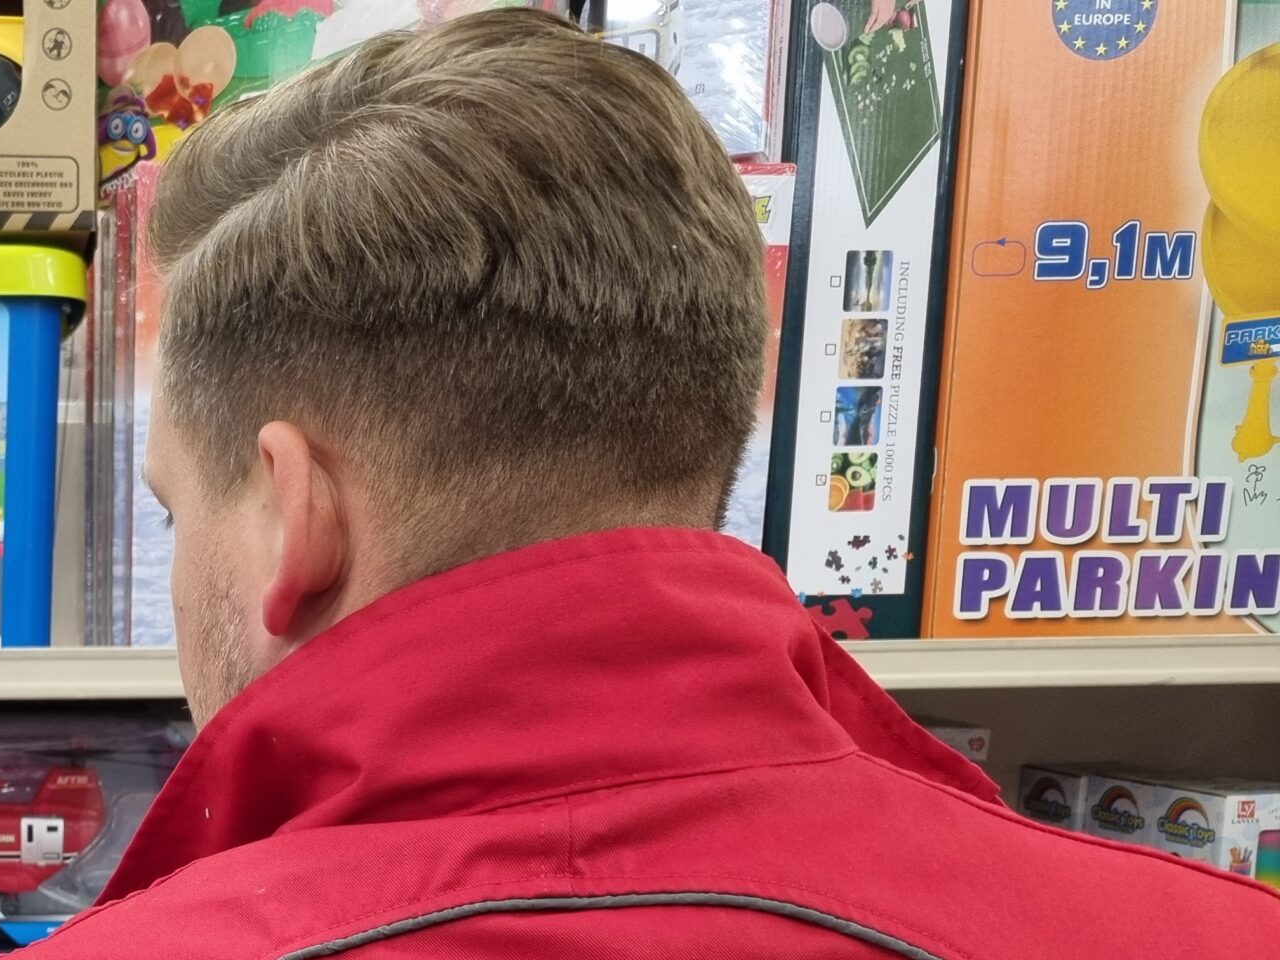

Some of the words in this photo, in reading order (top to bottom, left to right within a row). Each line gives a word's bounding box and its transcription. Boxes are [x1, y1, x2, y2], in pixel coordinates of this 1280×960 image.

[1074, 13, 1131, 26] EUROPE
[1096, 0, 1111, 10] IN
[893, 261, 910, 342] INCLUDING
[891, 346, 903, 380] FREE
[886, 385, 900, 438] PUZZLE
[884, 441, 896, 473] 1000
[882, 477, 893, 502] PCS
[959, 477, 1234, 546] MULTI
